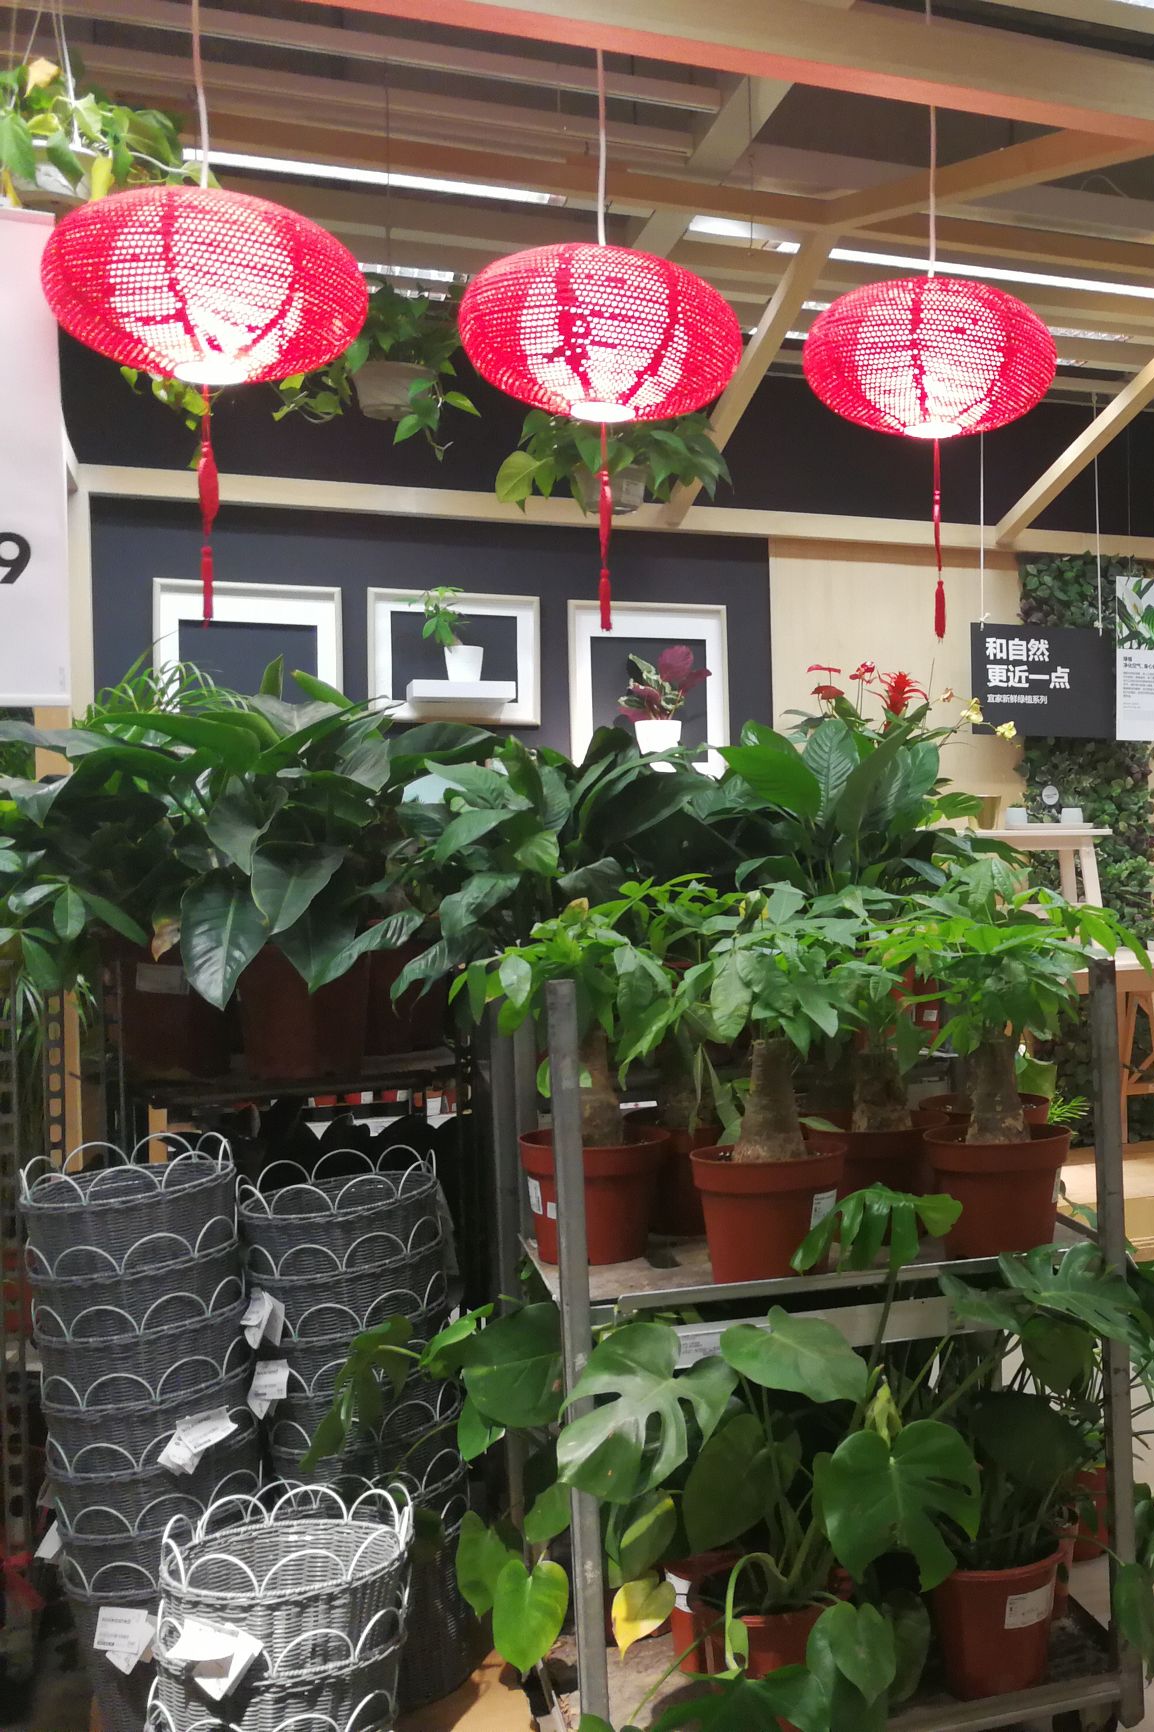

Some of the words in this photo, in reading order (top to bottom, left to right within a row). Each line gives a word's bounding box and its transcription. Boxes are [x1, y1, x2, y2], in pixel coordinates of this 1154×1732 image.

[0, 532, 31, 584] 9
[985, 637, 1050, 662] 和自然
[986, 664, 1071, 689] 更近一点
